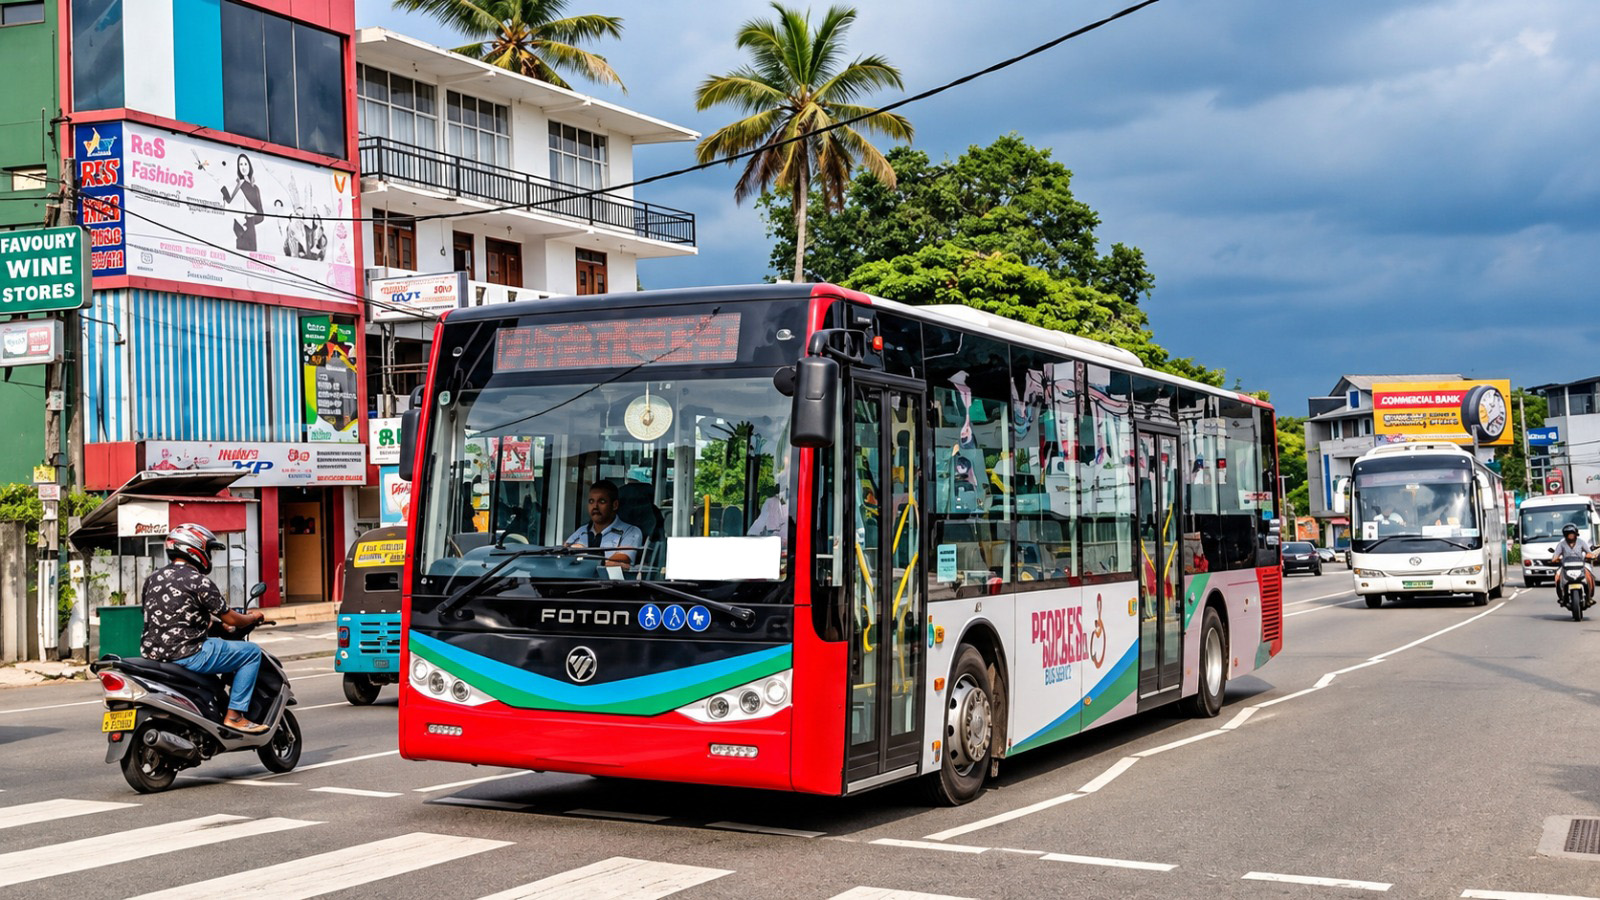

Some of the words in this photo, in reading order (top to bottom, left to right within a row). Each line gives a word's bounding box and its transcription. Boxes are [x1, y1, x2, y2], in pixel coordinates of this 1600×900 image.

[132, 160, 194, 189] Fashions
[0, 232, 76, 254] FAVOURY
[6, 256, 73, 279] WINE
[2, 282, 75, 303] STORES
[1435, 395, 1460, 404] BANK
[541, 608, 630, 625] FOTON
